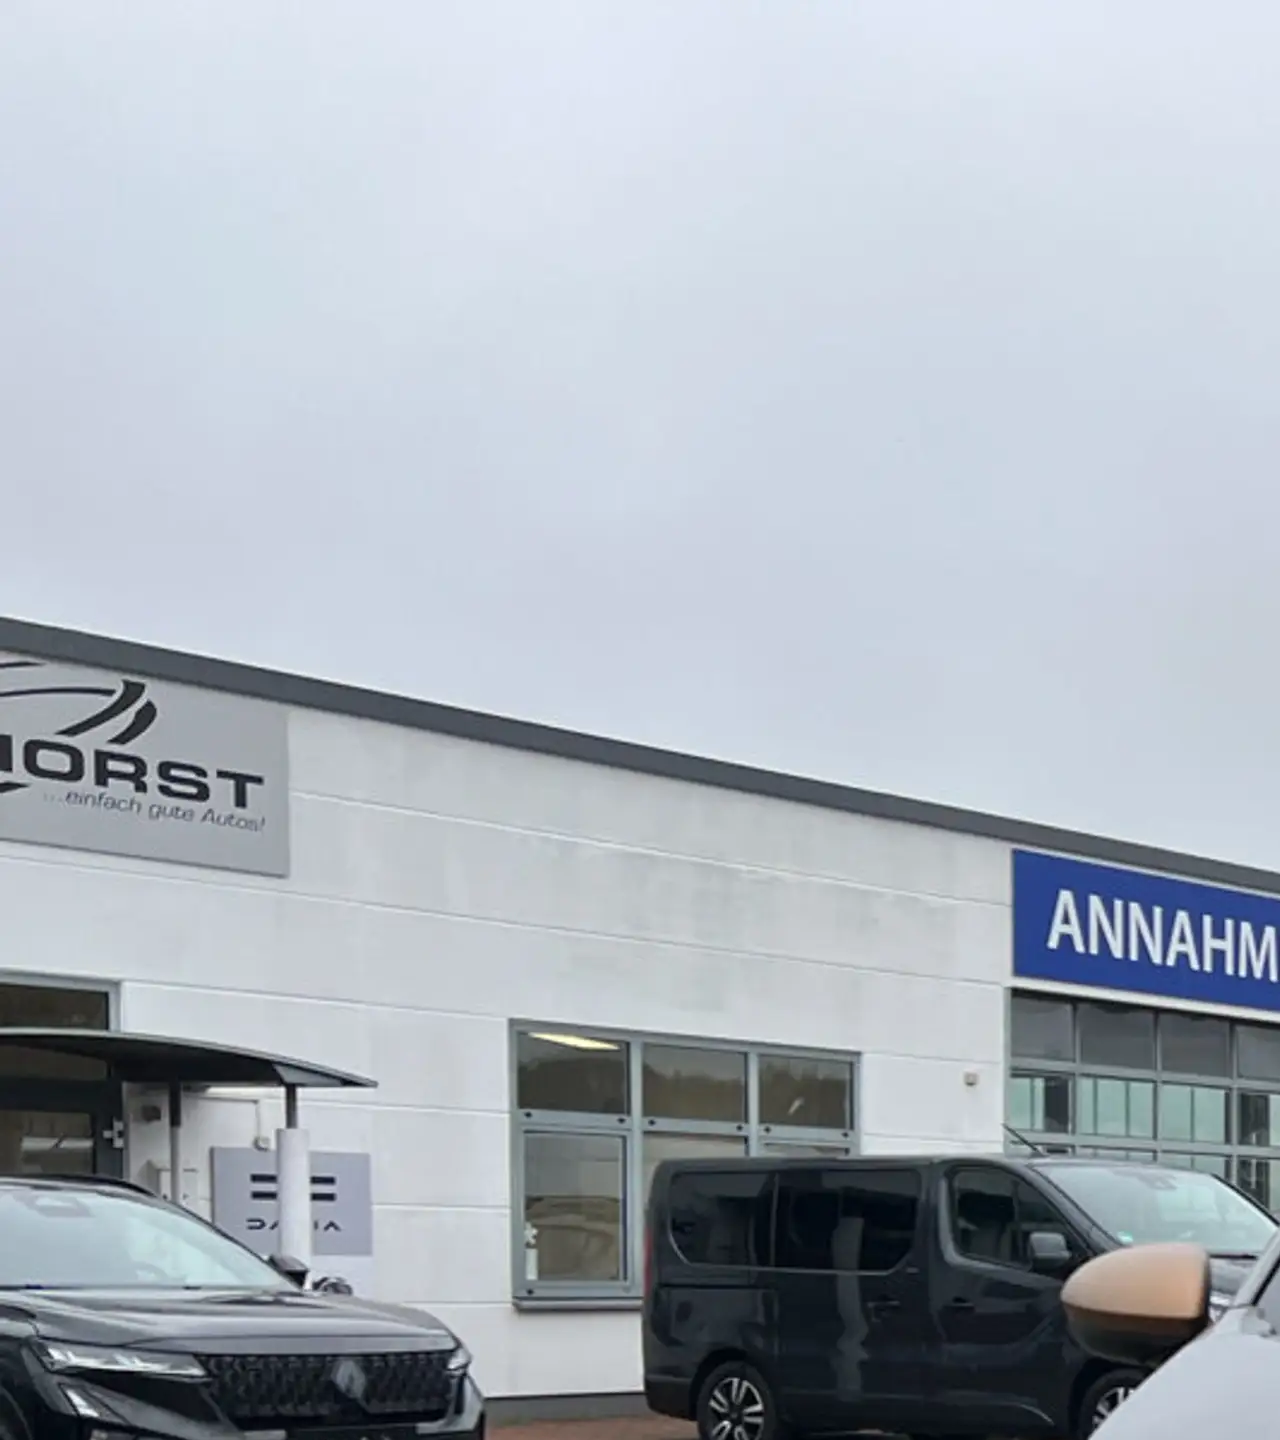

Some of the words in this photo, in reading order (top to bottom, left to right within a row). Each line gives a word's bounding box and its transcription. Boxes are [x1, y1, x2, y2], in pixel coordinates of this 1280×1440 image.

[0, 735, 264, 809] ORST
[148, 803, 196, 822] gute
[201, 808, 266, 832] Autos!
